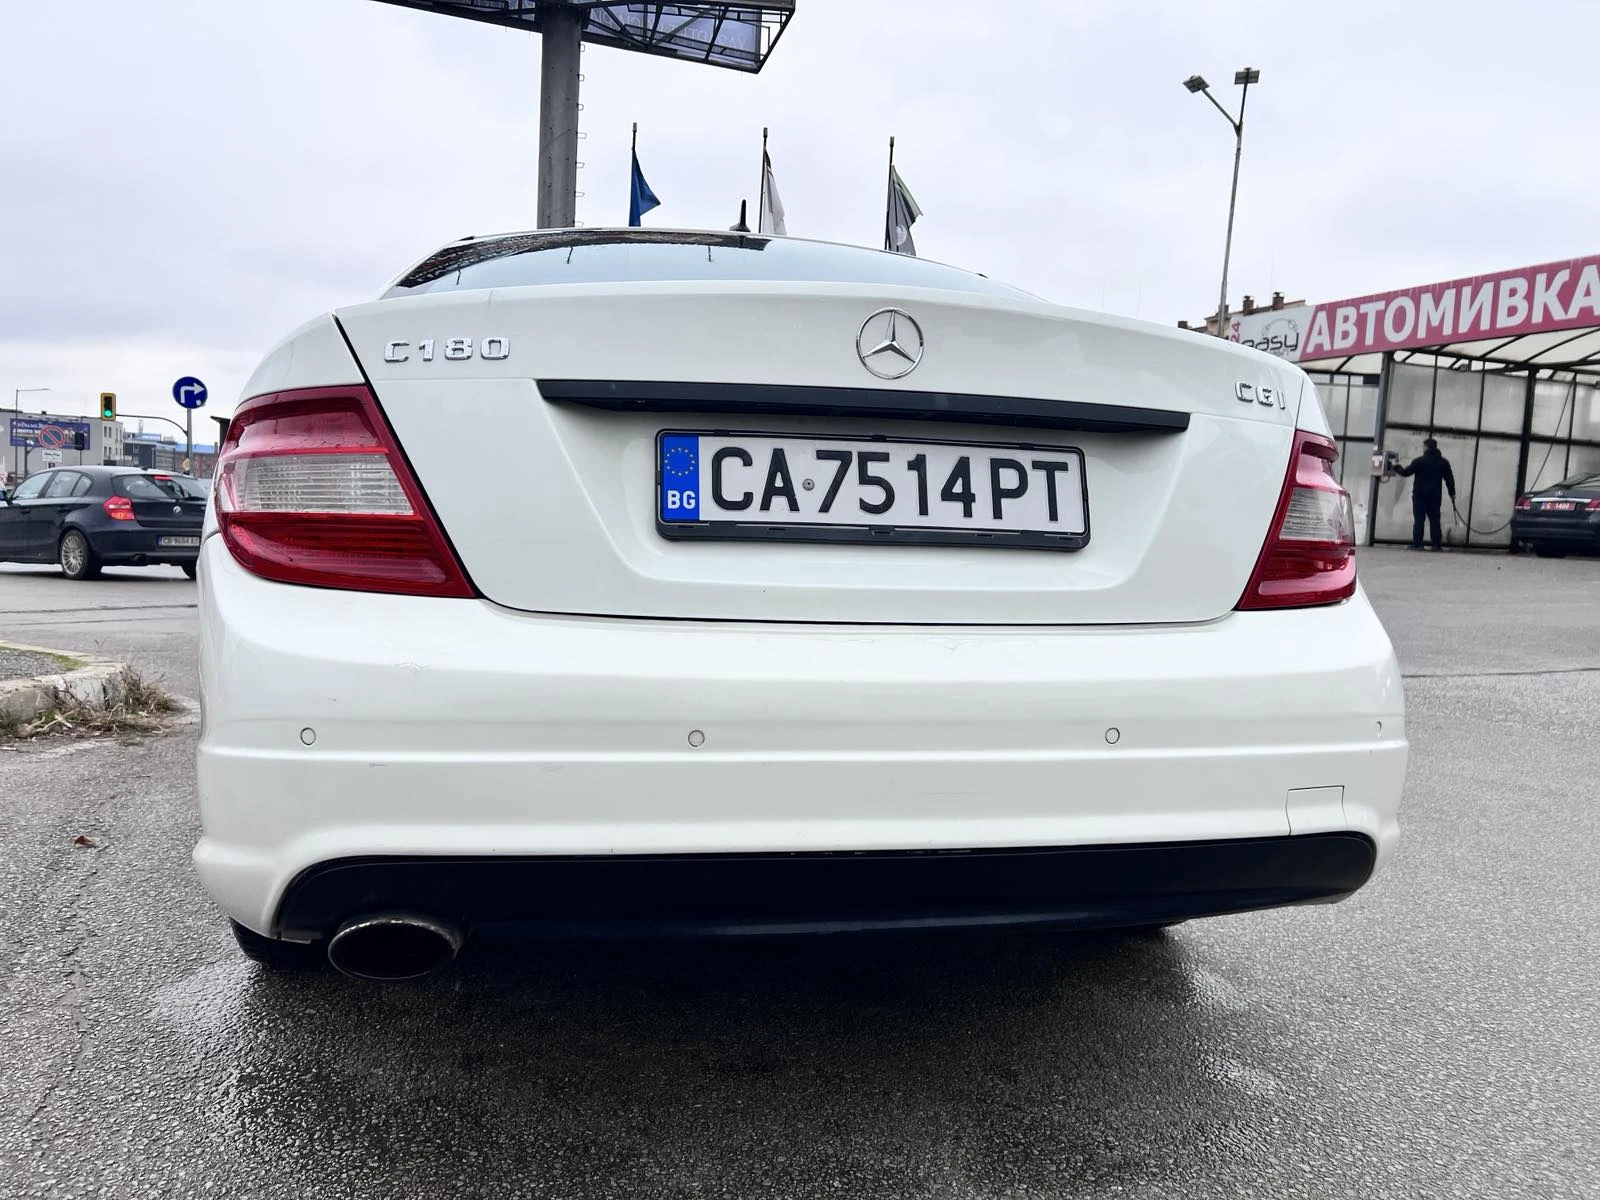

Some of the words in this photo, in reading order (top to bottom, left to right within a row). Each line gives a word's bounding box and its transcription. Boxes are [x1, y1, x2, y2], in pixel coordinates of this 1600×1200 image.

[1305, 264, 1600, 354] АВТОМИВКА
[1235, 380, 1286, 410] CGI
[667, 490, 697, 510] BG
